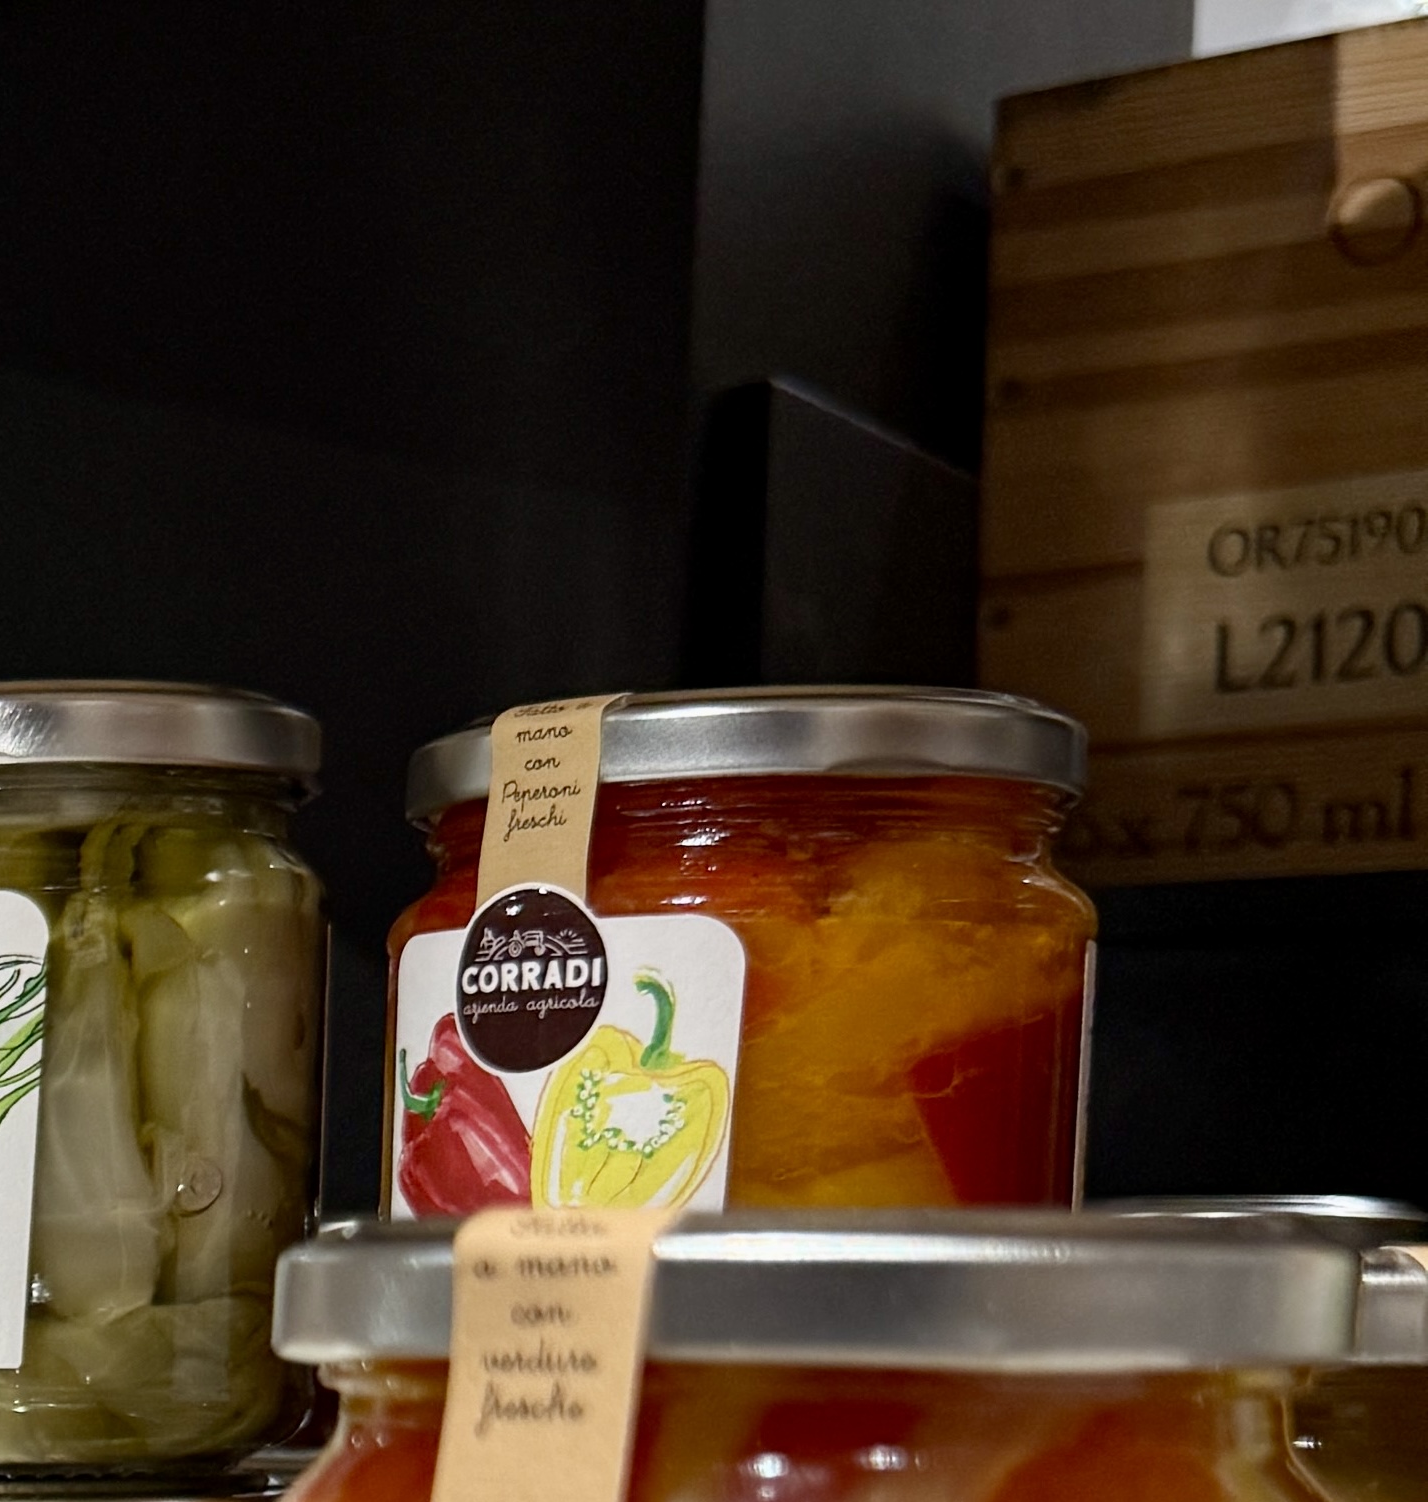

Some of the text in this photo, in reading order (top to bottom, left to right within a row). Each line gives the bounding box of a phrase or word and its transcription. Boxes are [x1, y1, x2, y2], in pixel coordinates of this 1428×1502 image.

[516, 725, 572, 743] mano
[524, 756, 561, 771] con
[501, 779, 581, 812] Peperoni
[502, 803, 567, 842] freschi
[462, 957, 603, 994] CORRADI
[463, 987, 600, 1024] azienda agricola
